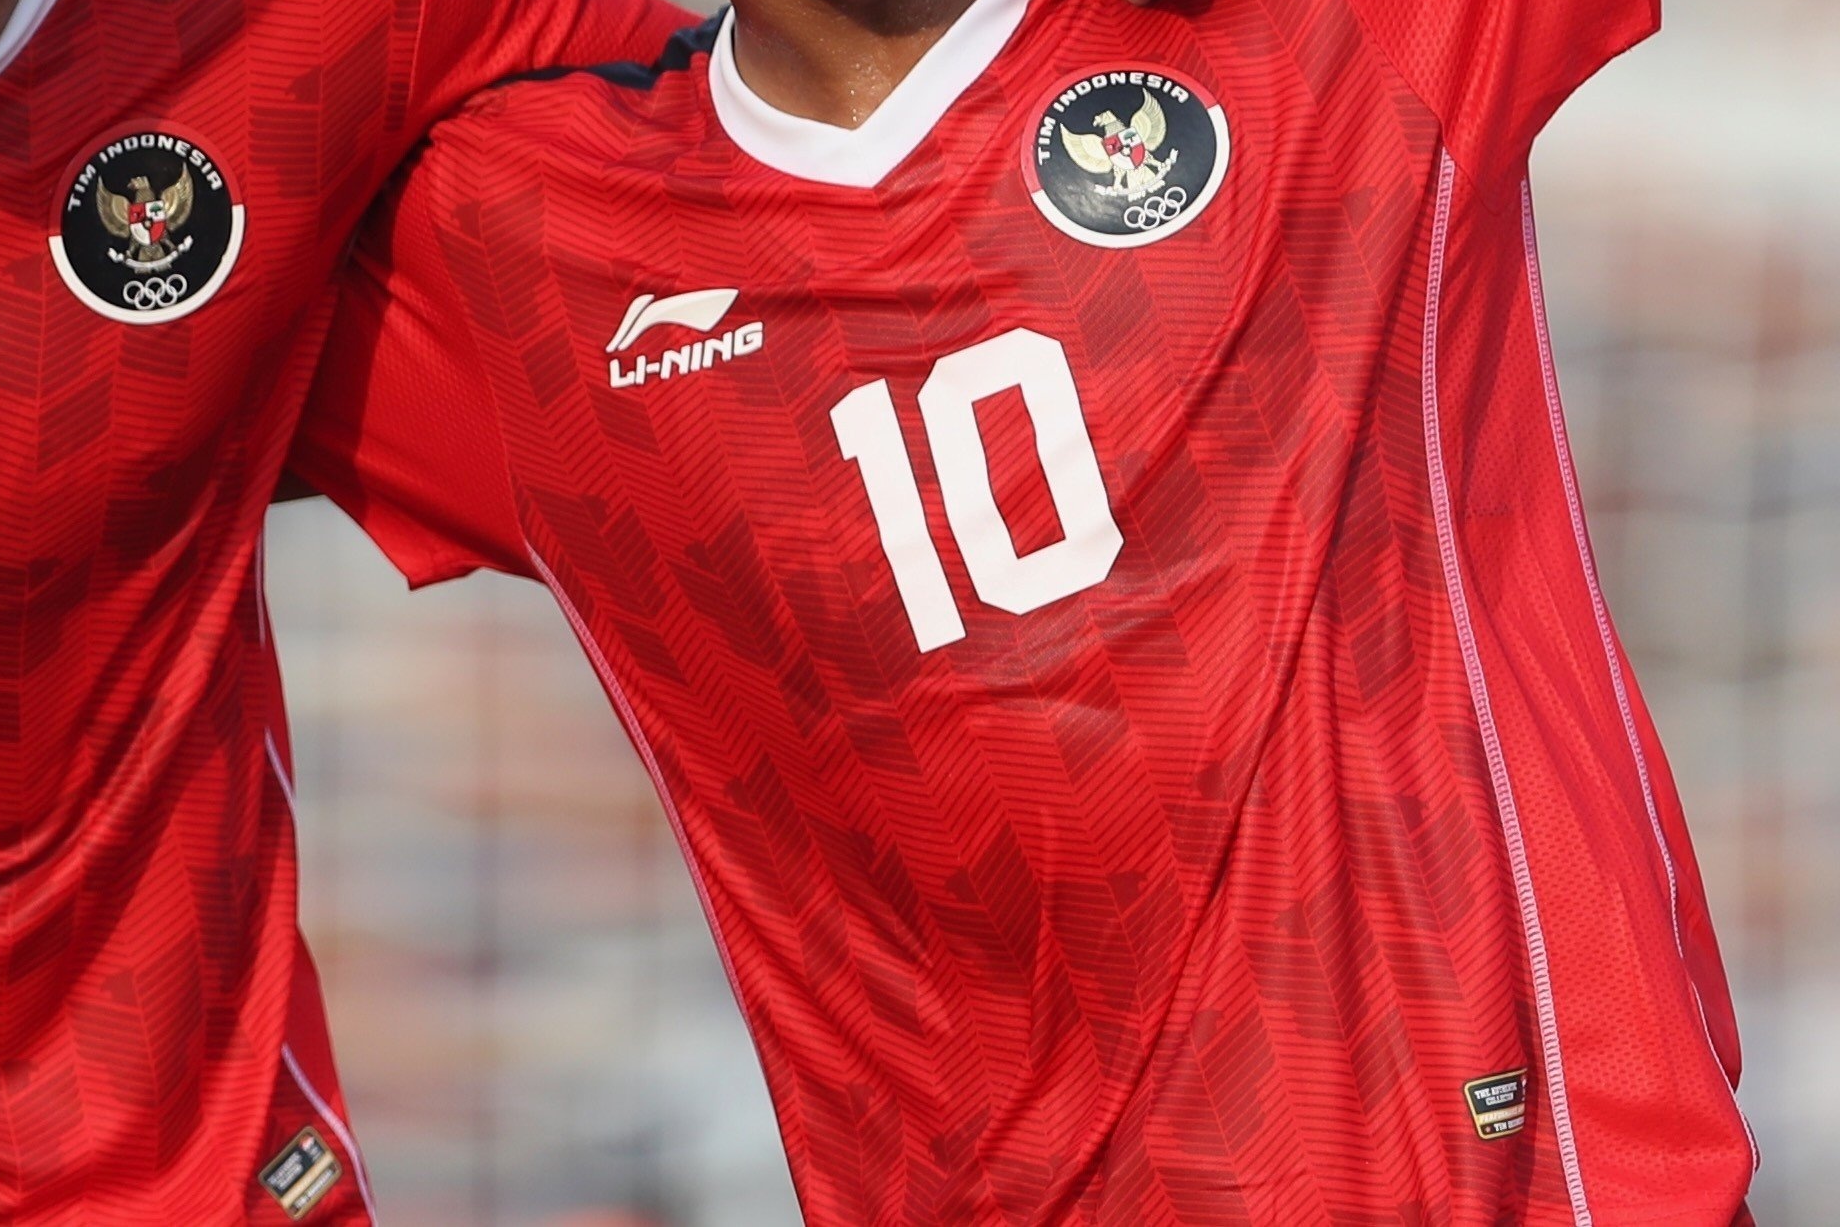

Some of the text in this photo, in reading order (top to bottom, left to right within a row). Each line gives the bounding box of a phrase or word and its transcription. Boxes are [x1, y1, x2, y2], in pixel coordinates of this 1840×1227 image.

[1037, 72, 1190, 166] TIM INDONESIA
[67, 134, 224, 212] TIM INDONESIA
[609, 321, 764, 389] LI-NING
[828, 326, 1126, 654] 10
